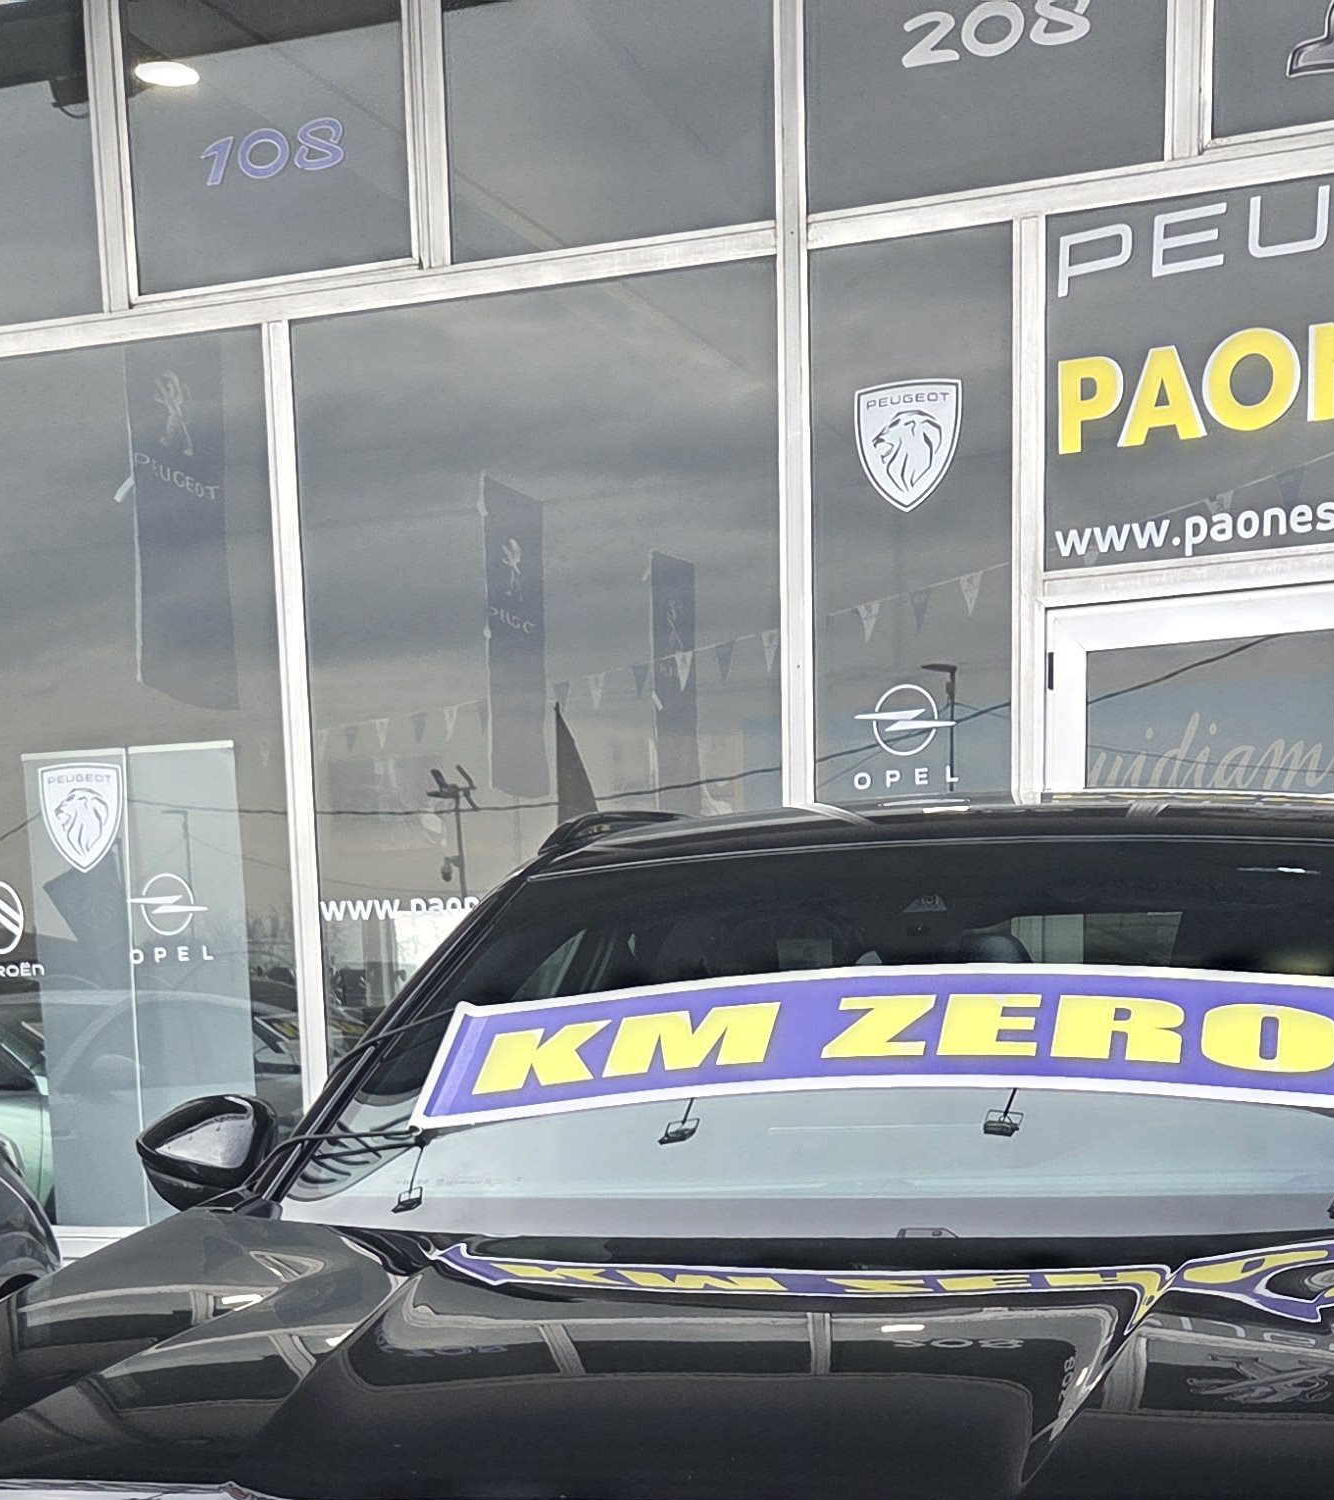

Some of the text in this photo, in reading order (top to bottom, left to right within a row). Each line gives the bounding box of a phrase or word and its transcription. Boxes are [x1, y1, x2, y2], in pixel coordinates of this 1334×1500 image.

[901, 0, 1091, 69] 208
[199, 117, 345, 186] 108
[866, 390, 951, 411] PEUGEOT
[47, 772, 113, 788] PEUGEOT
[853, 765, 959, 790] OPEL
[130, 945, 214, 965] OPEL
[472, 1001, 777, 1097] KM
